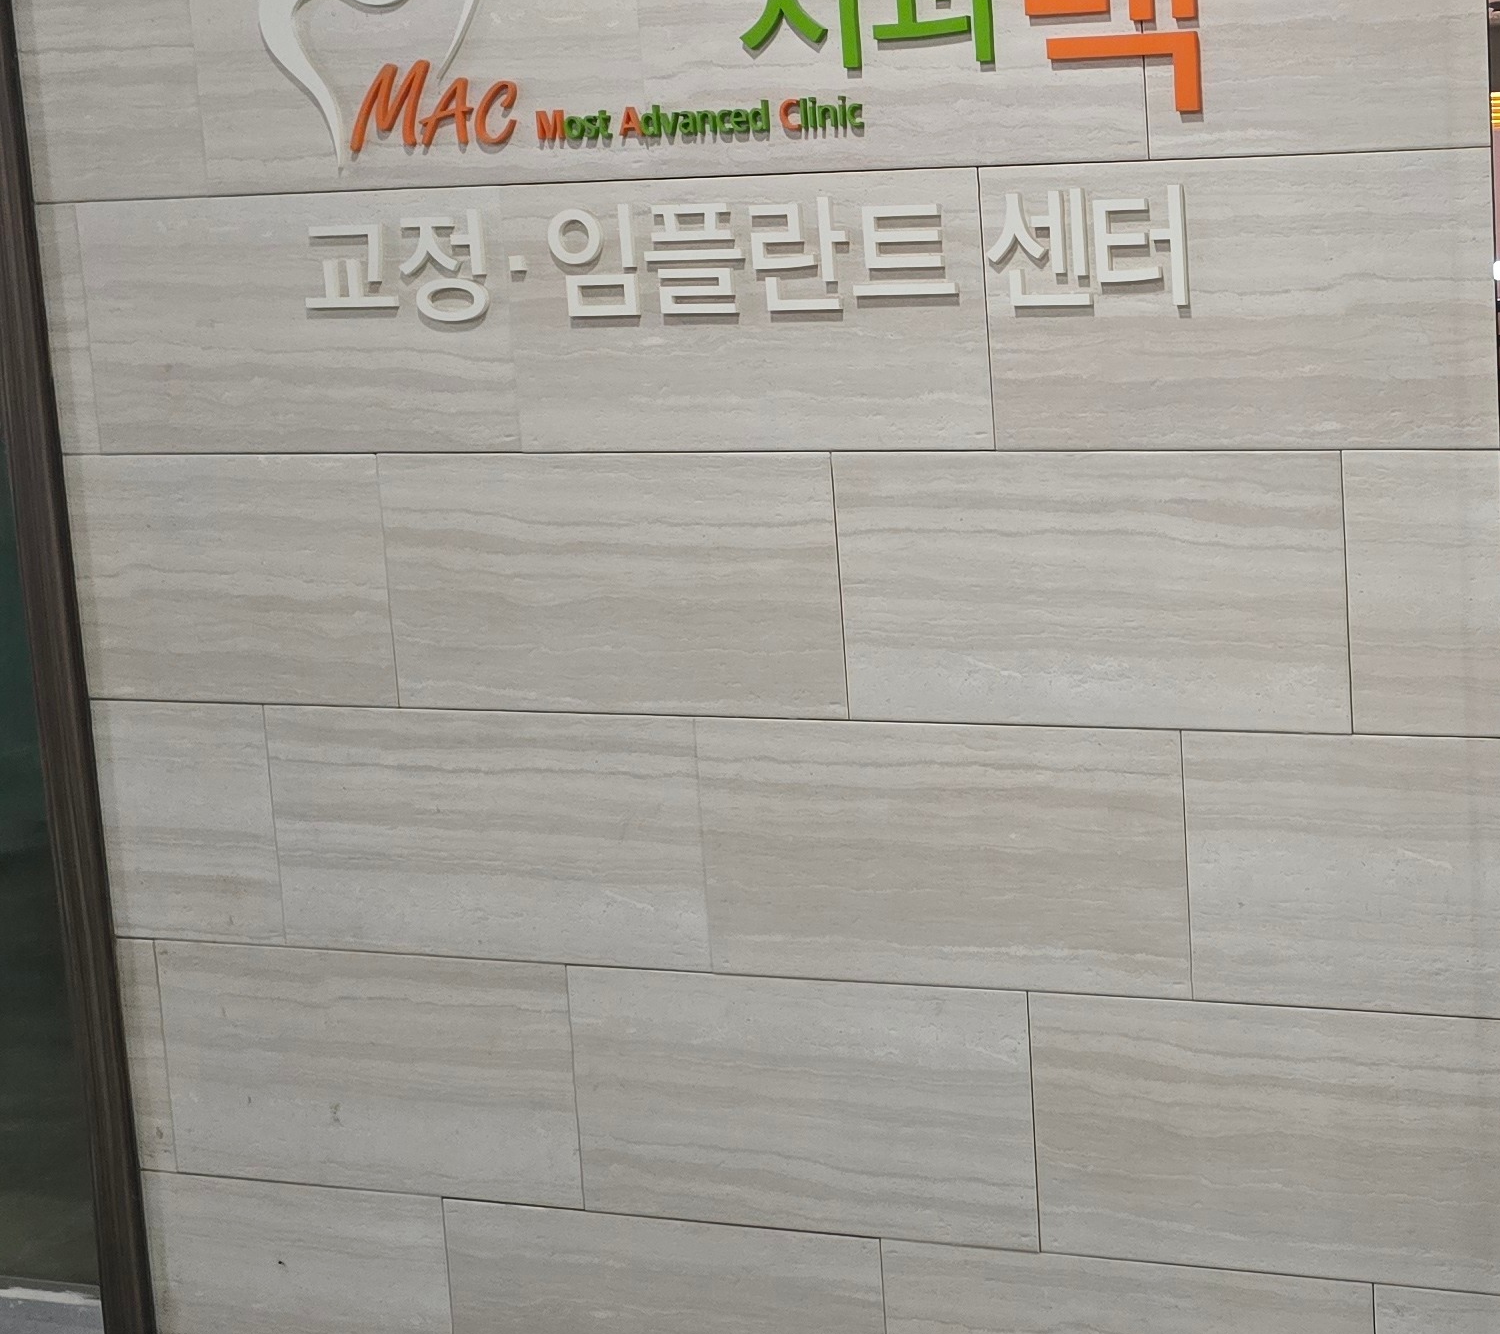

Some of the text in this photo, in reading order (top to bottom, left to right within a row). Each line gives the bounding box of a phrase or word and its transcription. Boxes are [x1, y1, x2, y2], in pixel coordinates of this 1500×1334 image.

[349, 59, 865, 154] MAC Most Advanced Clinic
[987, 183, 1190, 310] 센터
